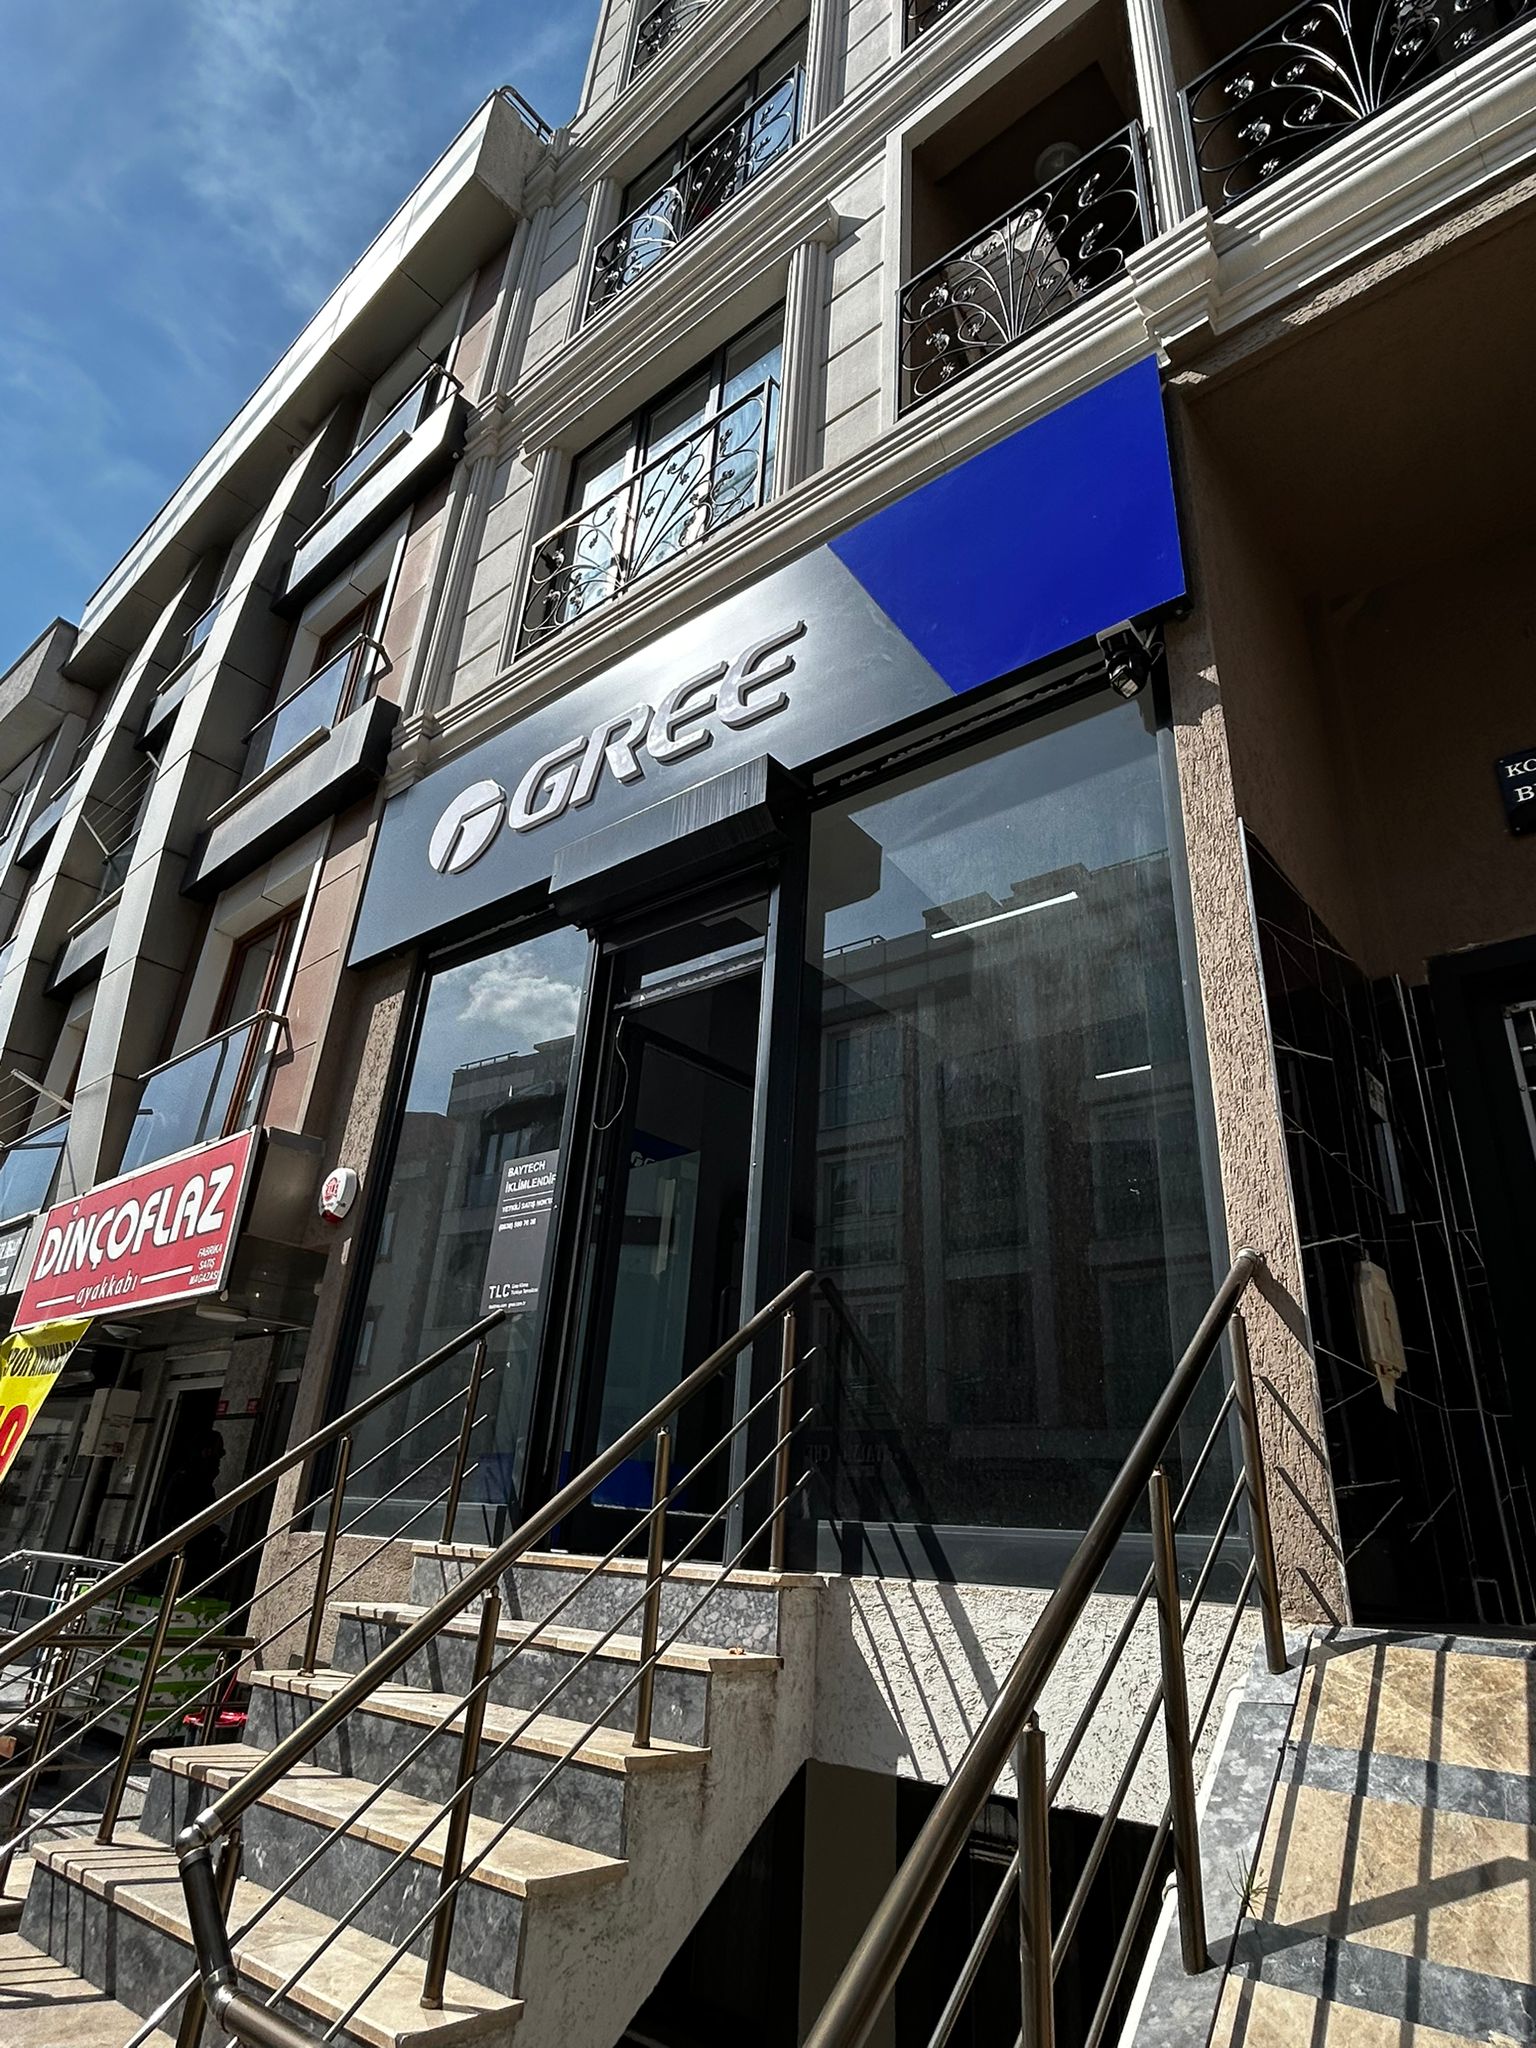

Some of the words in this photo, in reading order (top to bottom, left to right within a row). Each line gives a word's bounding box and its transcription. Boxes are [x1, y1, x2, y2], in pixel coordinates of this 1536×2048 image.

[508, 619, 808, 833] GREE
[1513, 784, 1536, 803] B
[507, 1159, 546, 1178] BAYTECH
[33, 1164, 235, 1282] DİNÇOFLAZ
[74, 1269, 138, 1309] ayakkabı
[489, 1283, 511, 1299] TLC
